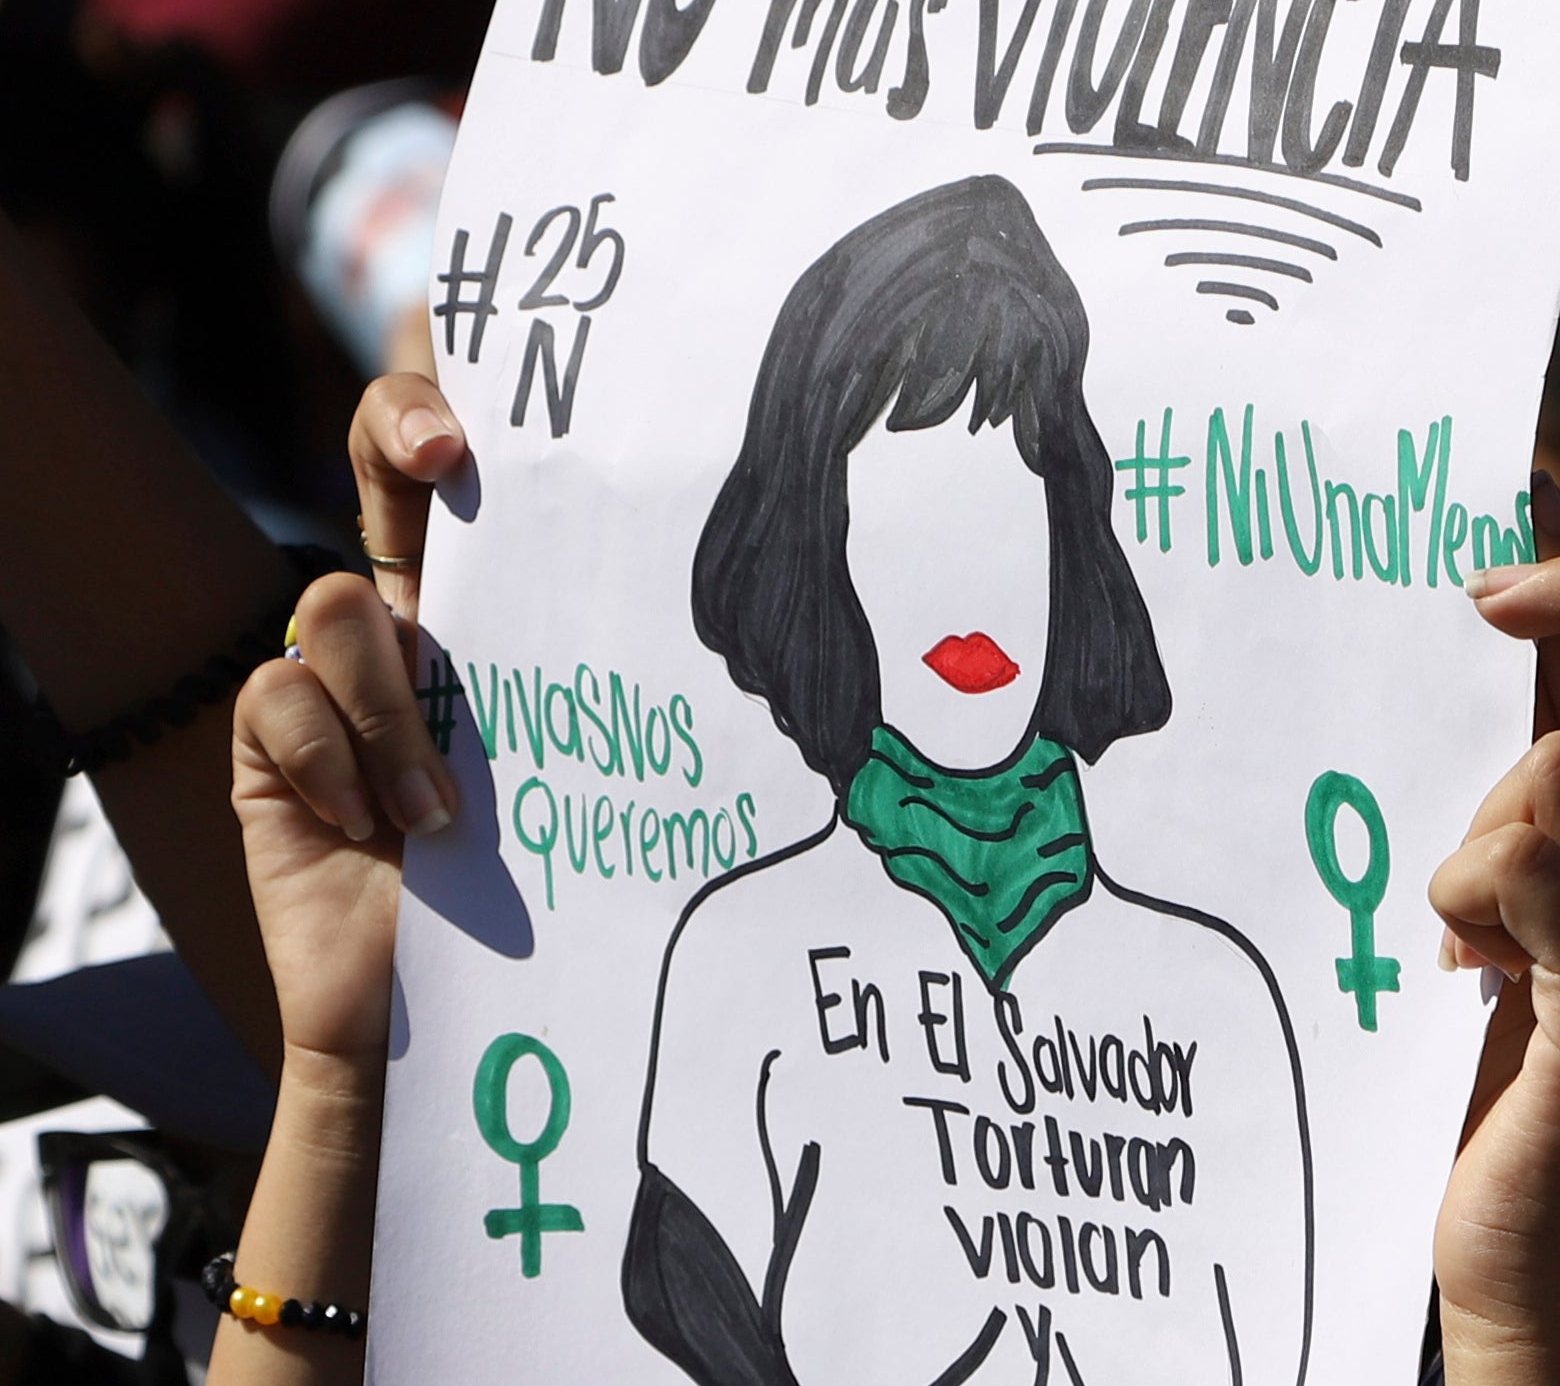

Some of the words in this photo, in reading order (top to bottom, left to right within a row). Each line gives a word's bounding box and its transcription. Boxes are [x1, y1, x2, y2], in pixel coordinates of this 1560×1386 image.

[510, 317, 591, 439] N
[513, 776, 756, 910] Queremos
[808, 946, 890, 1063] En
[918, 970, 971, 1082] El
[995, 991, 1197, 1116] Salvador
[902, 1097, 1195, 1212] Torturan
